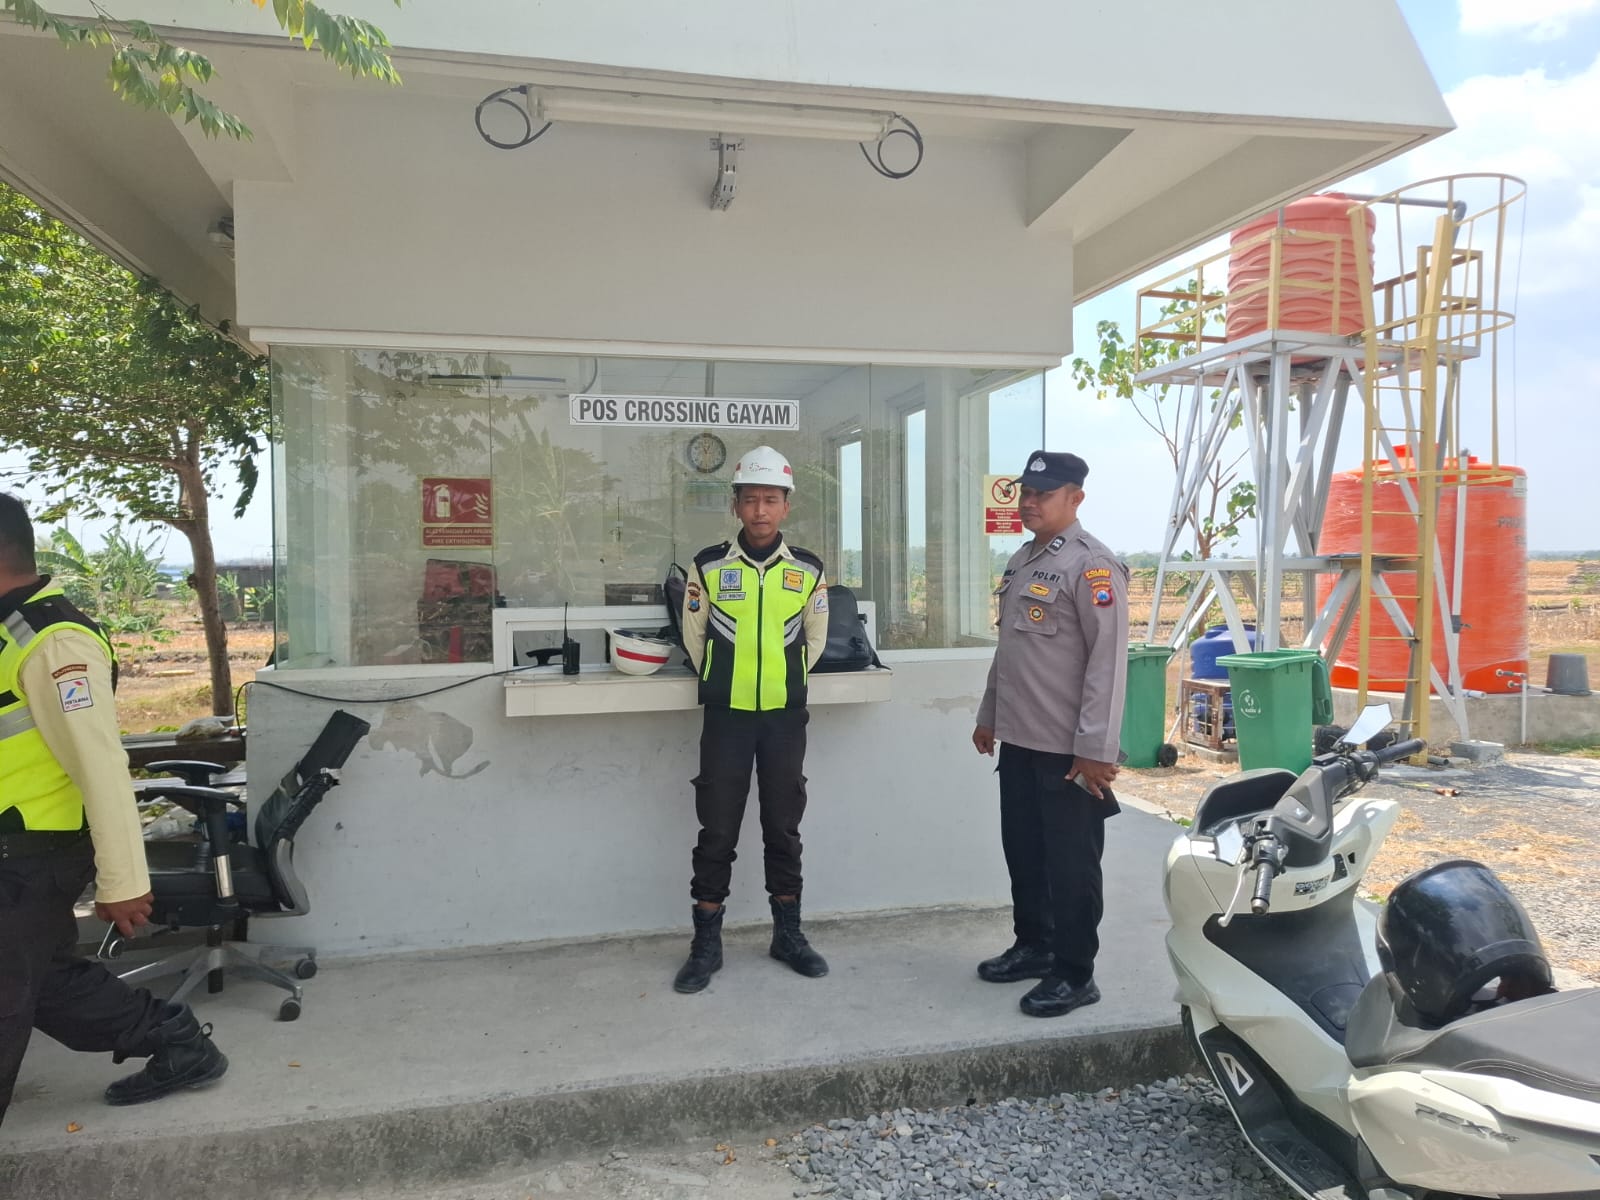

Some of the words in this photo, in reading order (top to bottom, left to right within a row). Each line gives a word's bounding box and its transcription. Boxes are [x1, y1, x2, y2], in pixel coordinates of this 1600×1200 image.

[579, 398, 618, 421] POS
[624, 399, 720, 424] CROSSING
[726, 402, 791, 425] GAYAM
[1032, 570, 1061, 583] POLRI
[64, 696, 89, 705] PERTAMINA
[1415, 1102, 1493, 1135] PCX
